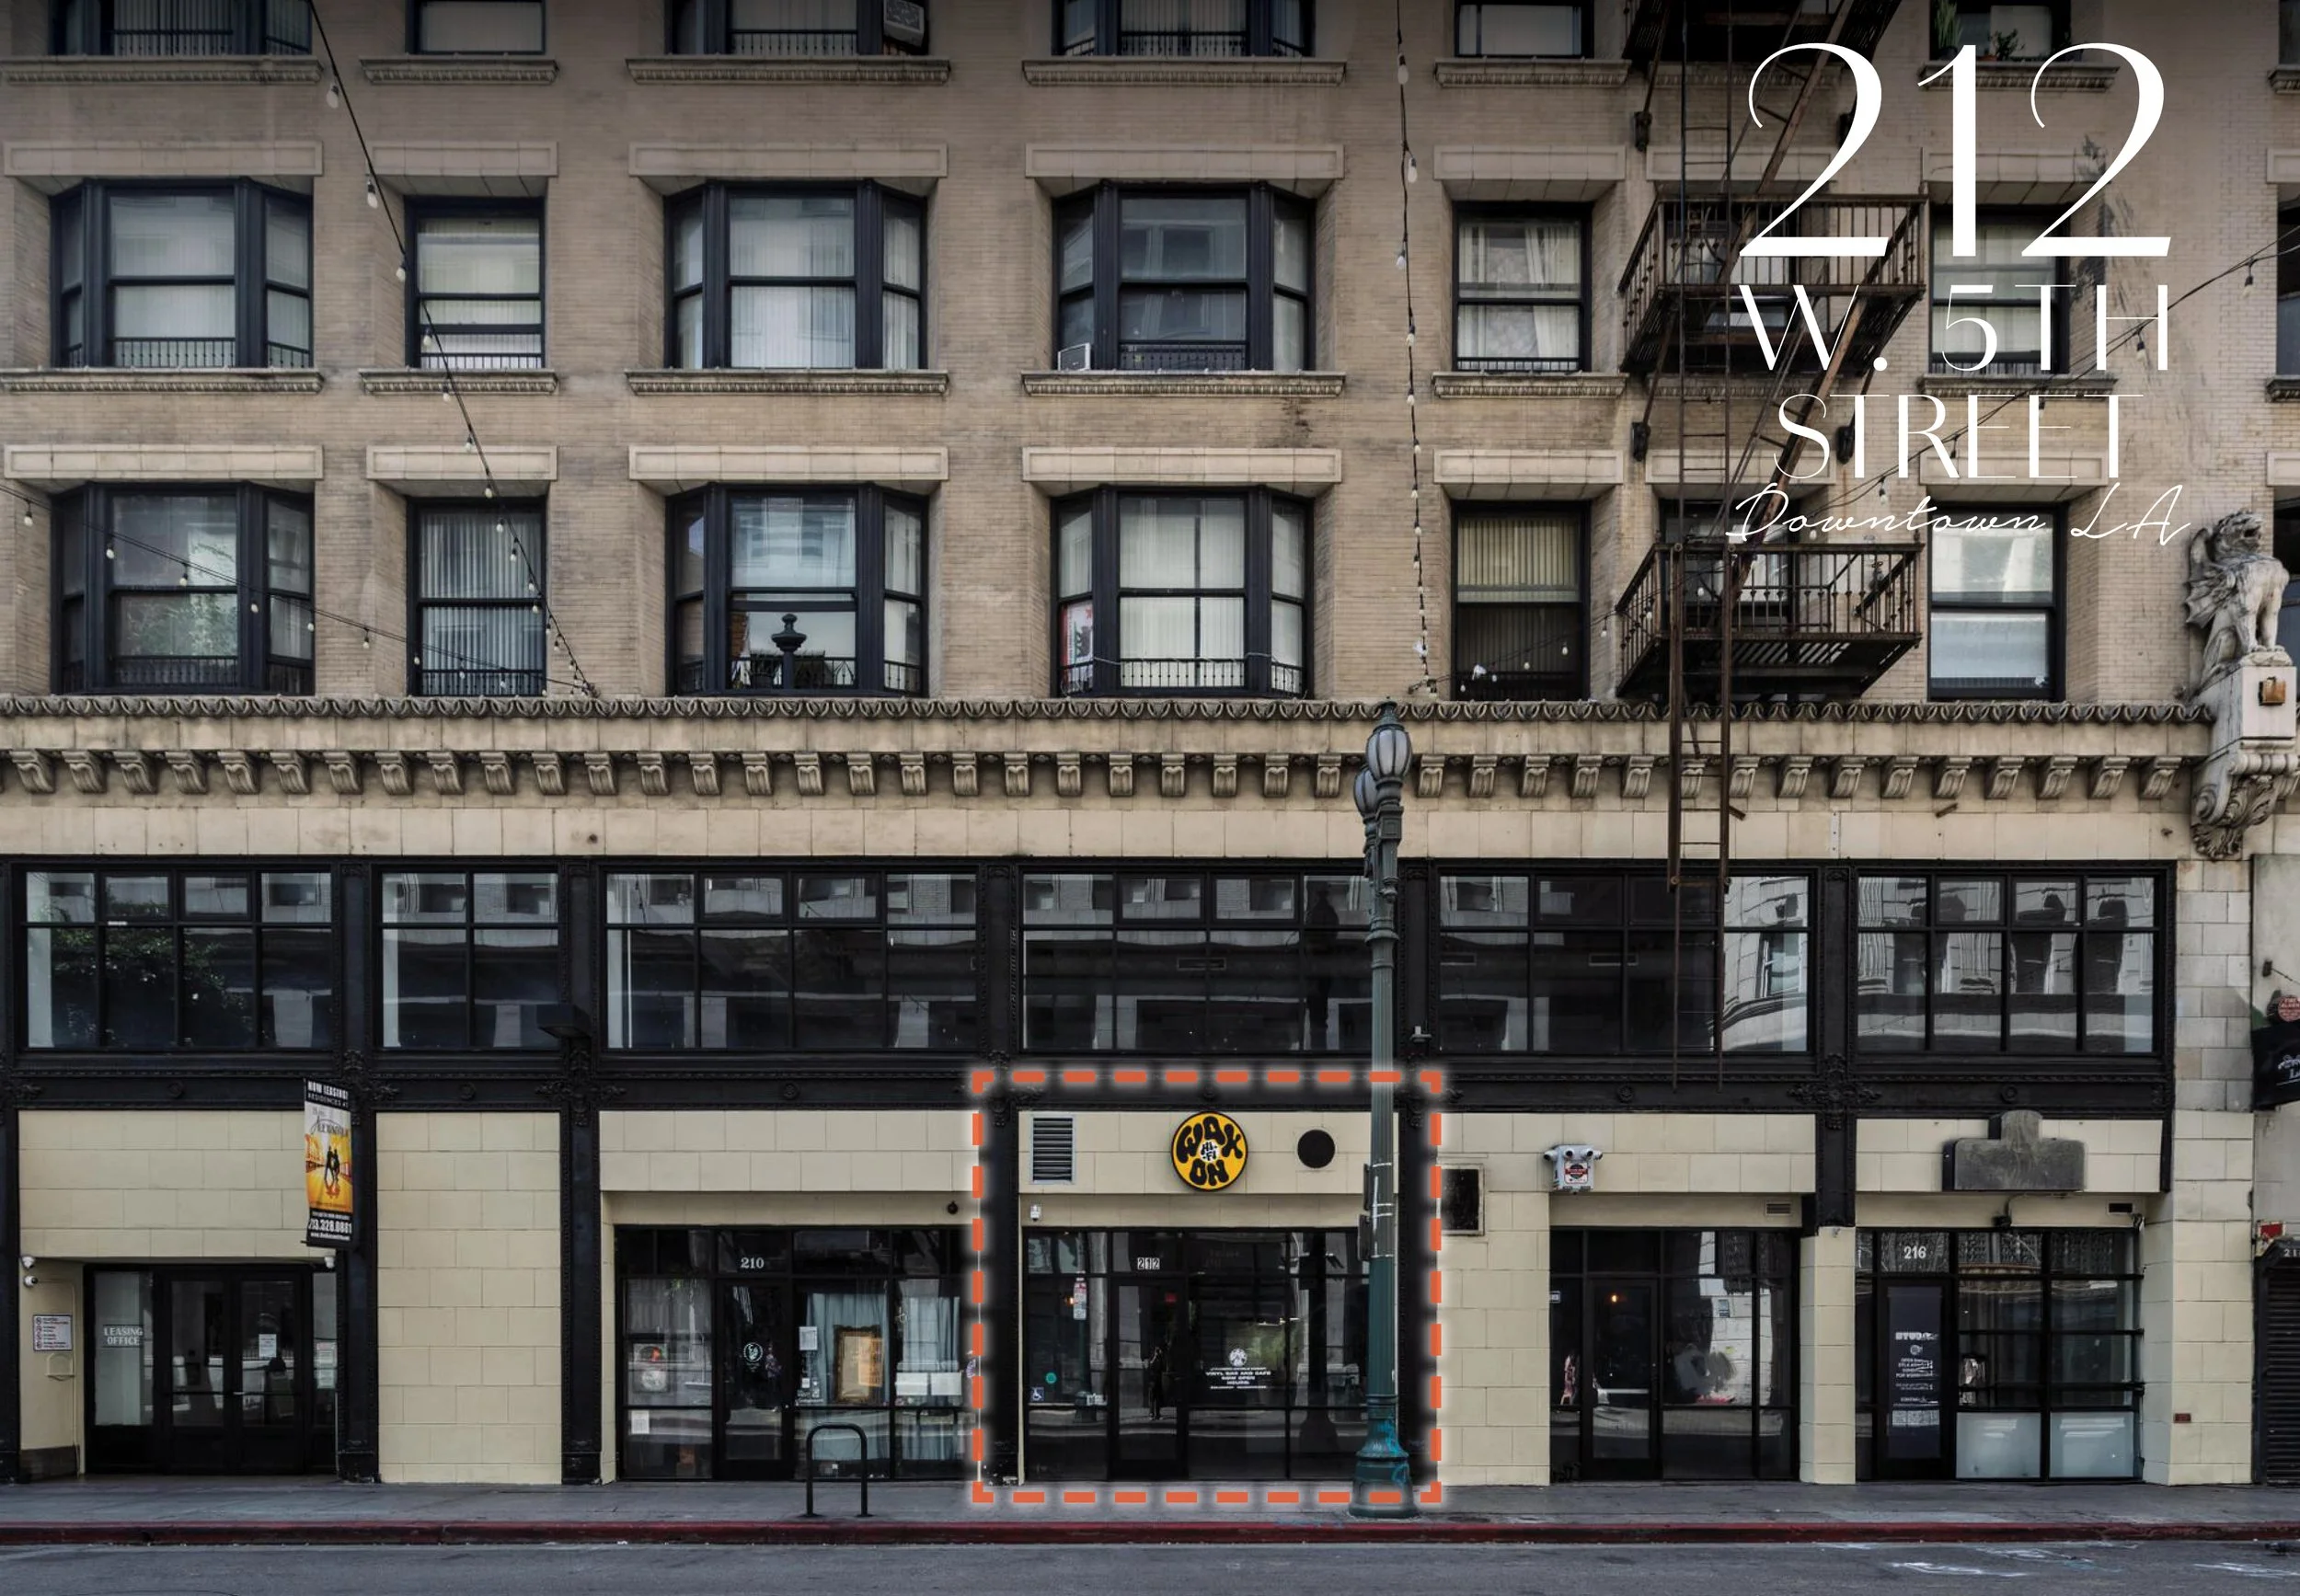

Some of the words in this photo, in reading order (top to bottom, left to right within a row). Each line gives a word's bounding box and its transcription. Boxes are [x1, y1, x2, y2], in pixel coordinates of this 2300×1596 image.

[1176, 1116, 1243, 1164] WAX
[1190, 1158, 1230, 1187] ON
[1903, 1246, 1927, 1259] 216
[2283, 1248, 2300, 1258] 21
[740, 1257, 765, 1269] 210
[1137, 1257, 1160, 1270] 212
[103, 1326, 144, 1337] LEASING
[107, 1337, 141, 1346] OFFICE
